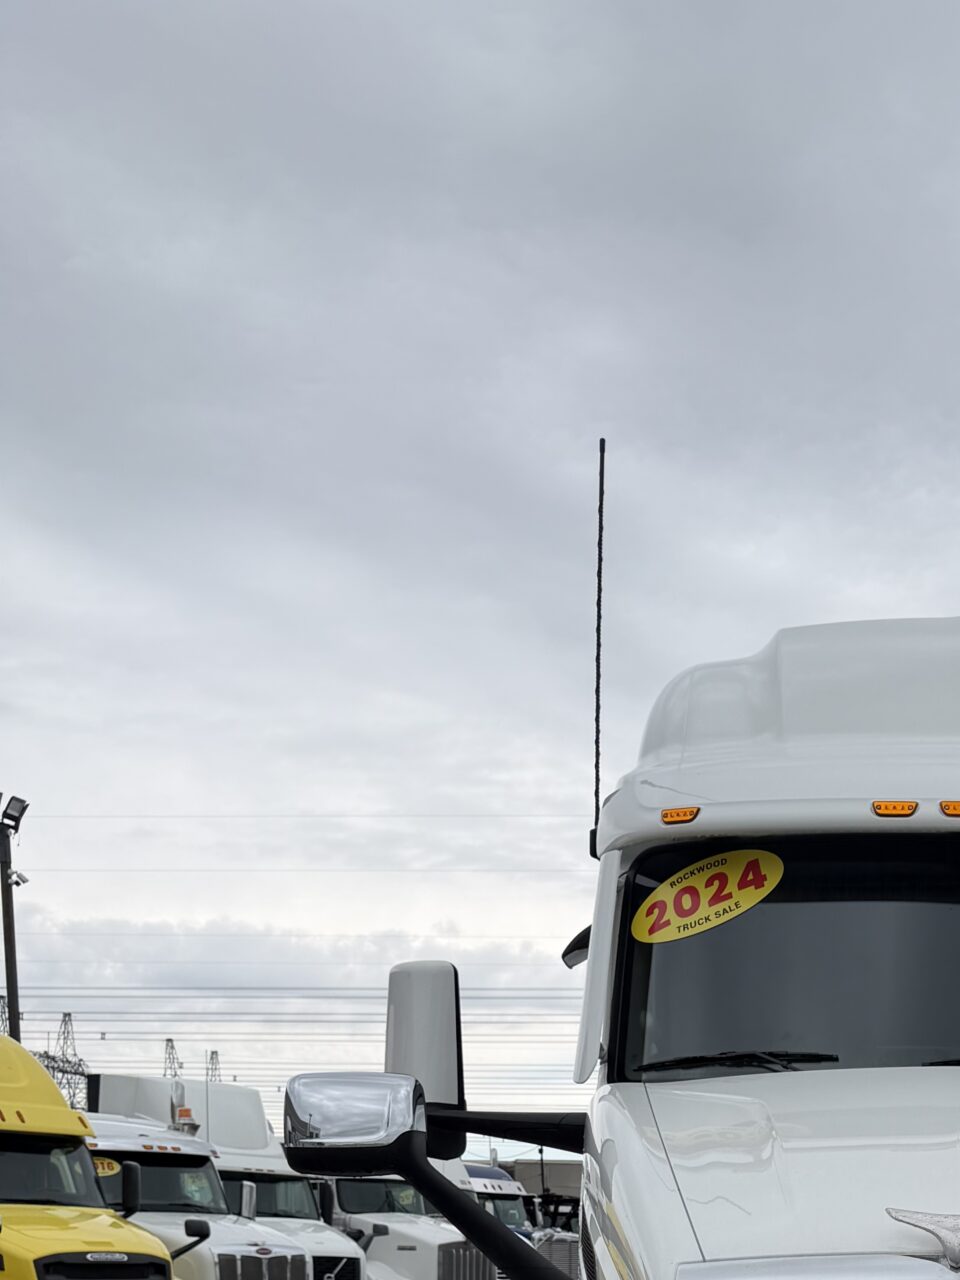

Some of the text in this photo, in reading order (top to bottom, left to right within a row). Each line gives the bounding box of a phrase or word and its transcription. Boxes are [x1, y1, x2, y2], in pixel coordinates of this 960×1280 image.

[670, 858, 728, 889] ROCKWOOD
[645, 858, 768, 937] 2024
[676, 900, 743, 934] TRUCK SALE
